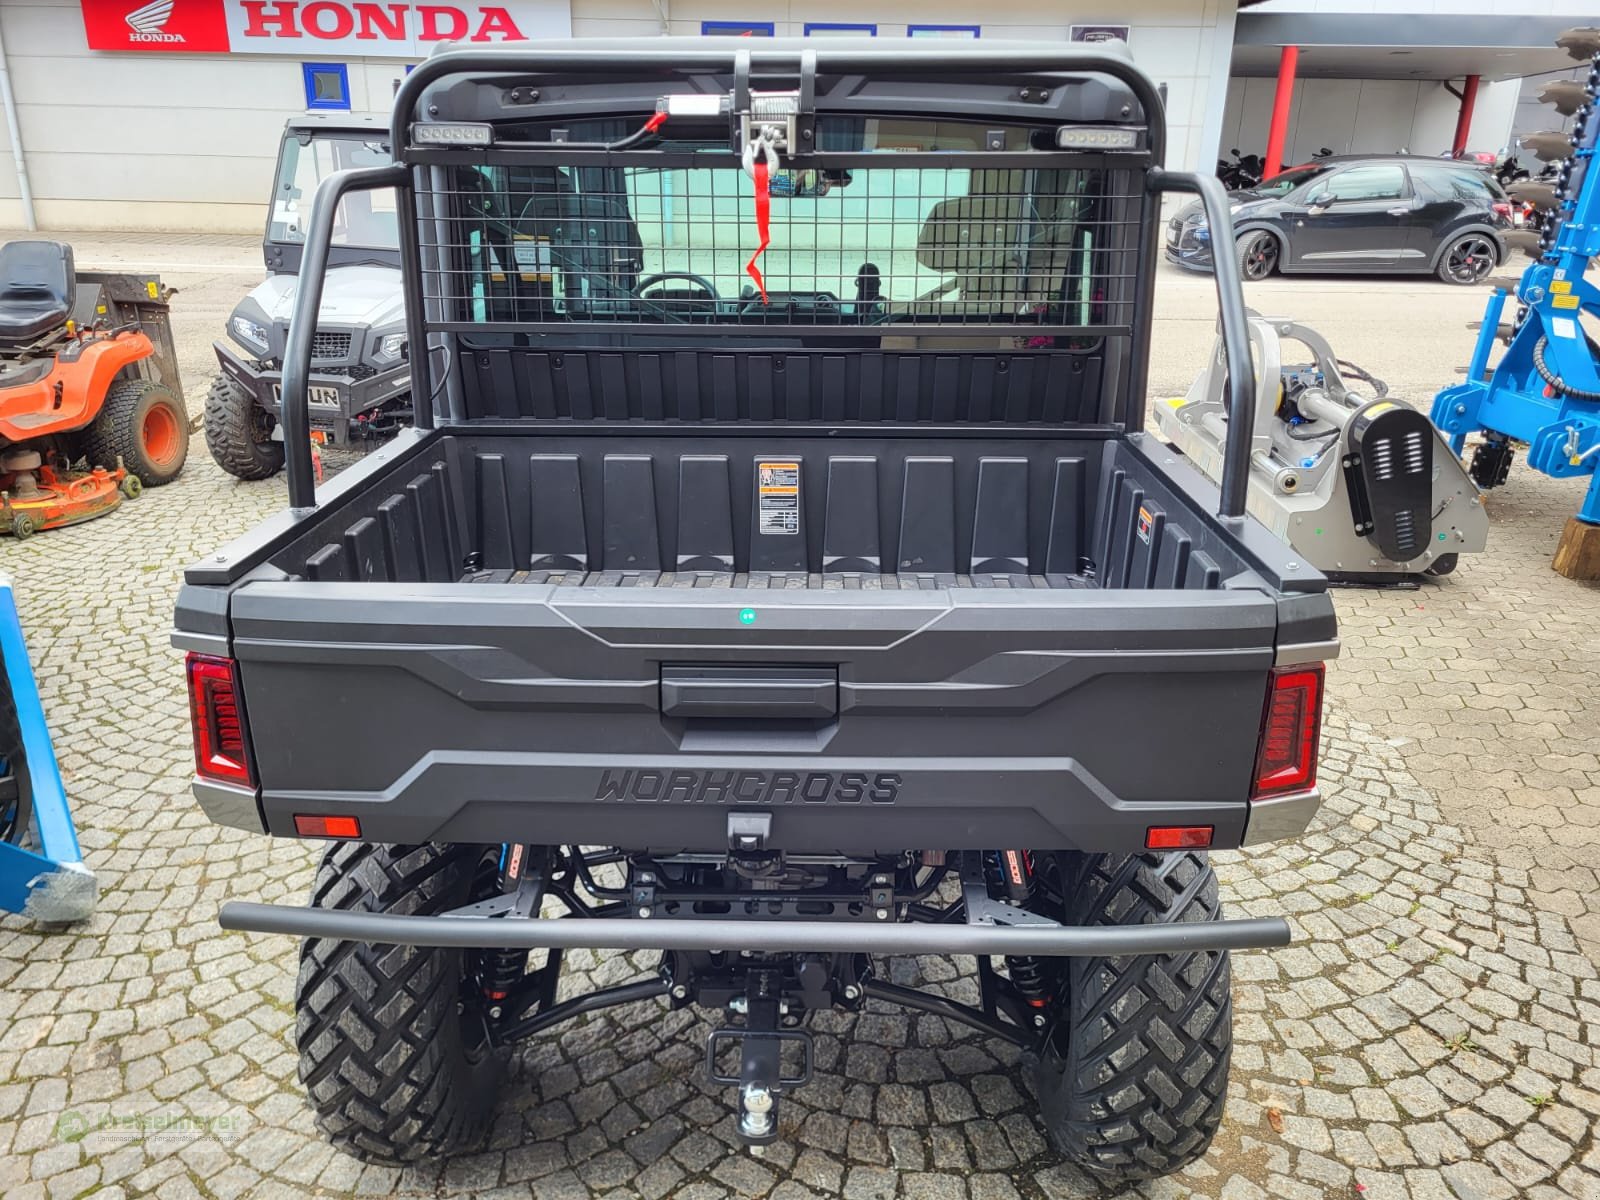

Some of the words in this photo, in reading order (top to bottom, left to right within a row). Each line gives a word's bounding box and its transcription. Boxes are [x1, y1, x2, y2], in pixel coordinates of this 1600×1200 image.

[128, 33, 187, 43] HONDA
[240, 1, 529, 42] HONDA
[594, 769, 903, 805] WORKCROSS
